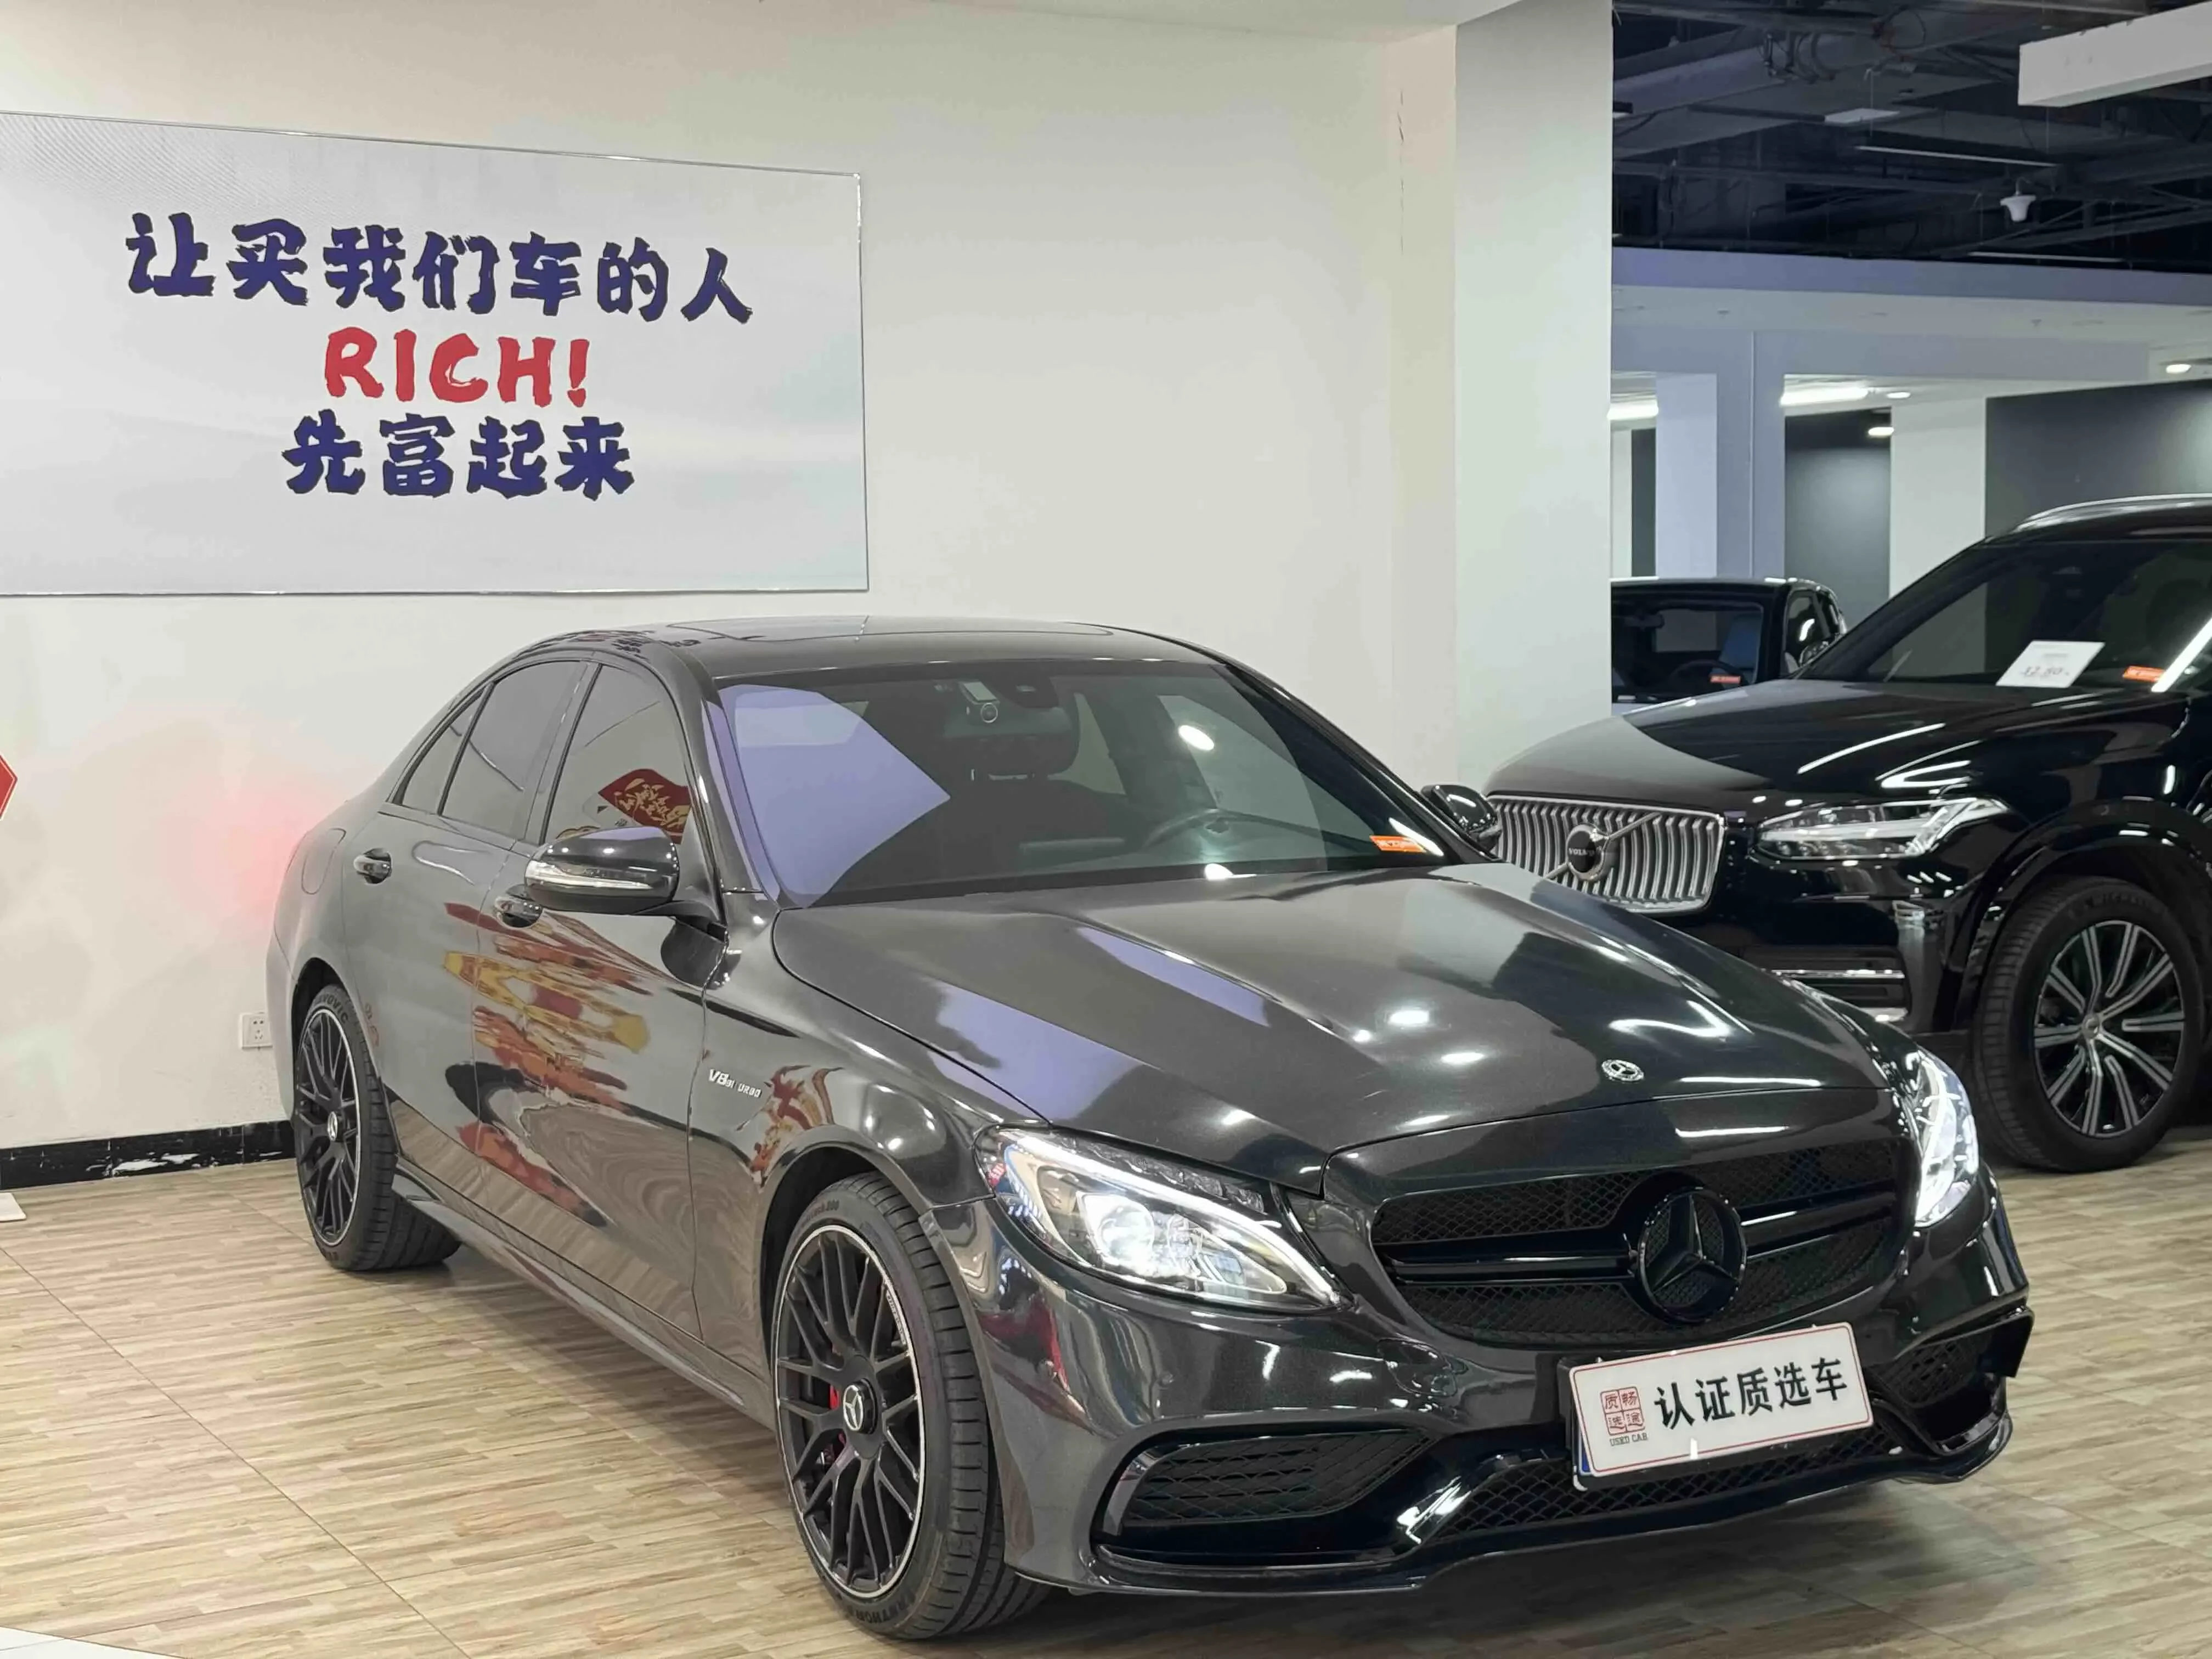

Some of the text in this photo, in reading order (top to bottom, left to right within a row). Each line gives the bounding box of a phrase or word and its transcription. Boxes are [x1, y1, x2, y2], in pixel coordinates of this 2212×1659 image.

[125, 213, 752, 324] 让买我们车的人
[325, 327, 590, 407] RICH!
[283, 410, 635, 500] 先富起来
[1654, 1357, 1847, 1429] 认证质选车
